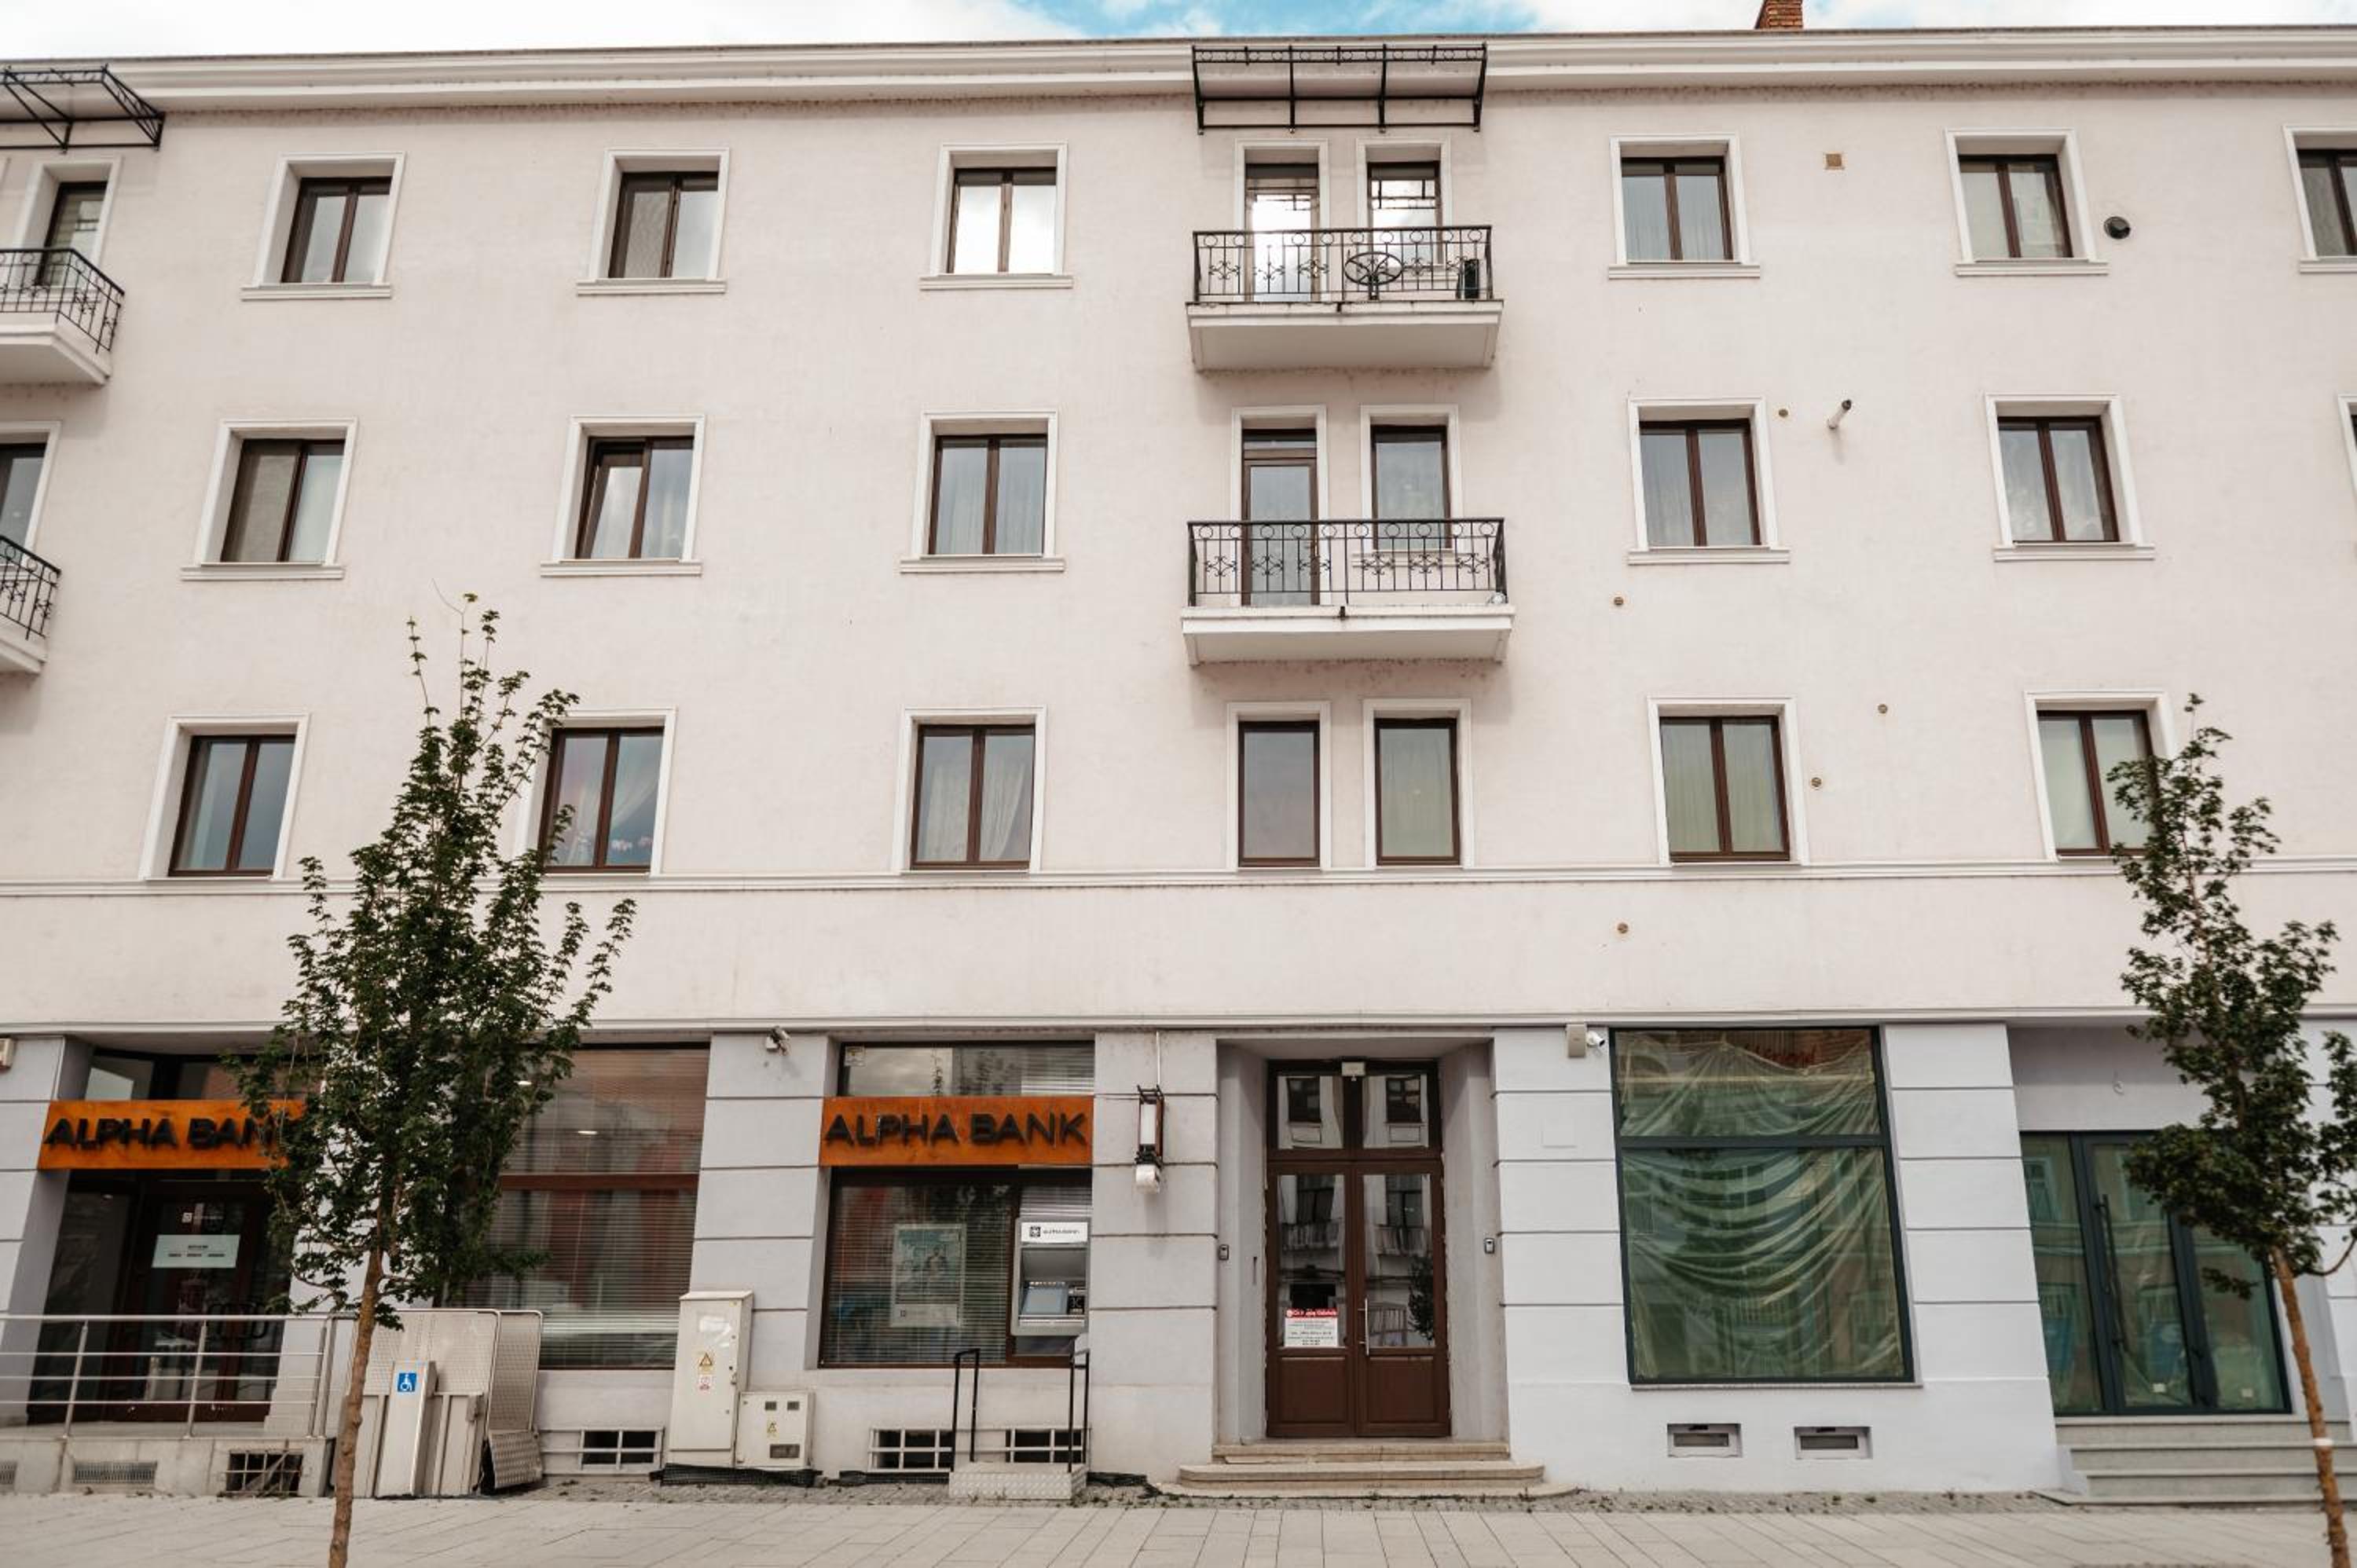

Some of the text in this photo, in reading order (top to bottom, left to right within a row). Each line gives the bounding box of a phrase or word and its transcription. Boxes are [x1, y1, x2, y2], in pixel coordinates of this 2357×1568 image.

[44, 1117, 178, 1150] ALPHA
[825, 1112, 1087, 1146] ALPHA BANK
